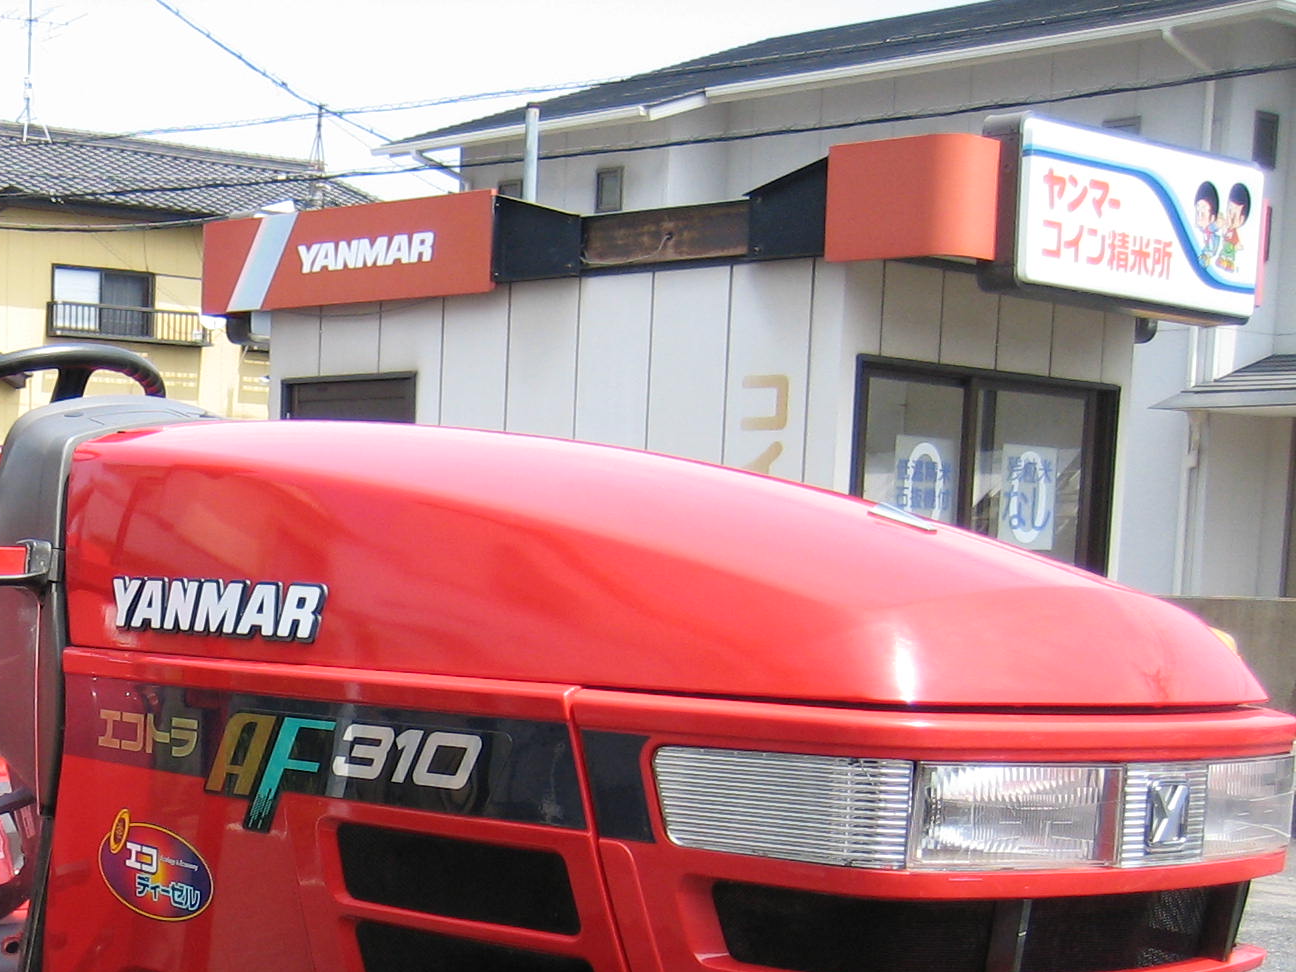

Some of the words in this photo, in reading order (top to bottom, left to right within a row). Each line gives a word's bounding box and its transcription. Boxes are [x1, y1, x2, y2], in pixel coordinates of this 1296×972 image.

[1042, 168, 1121, 218] ヤンマー
[296, 231, 436, 274] YANMAR
[1041, 219, 1173, 280] コイン精米所
[112, 575, 328, 643] YANMAR
[98, 708, 200, 758] エコトラ
[125, 841, 159, 875] エコ
[136, 873, 201, 911] ディーゼル
